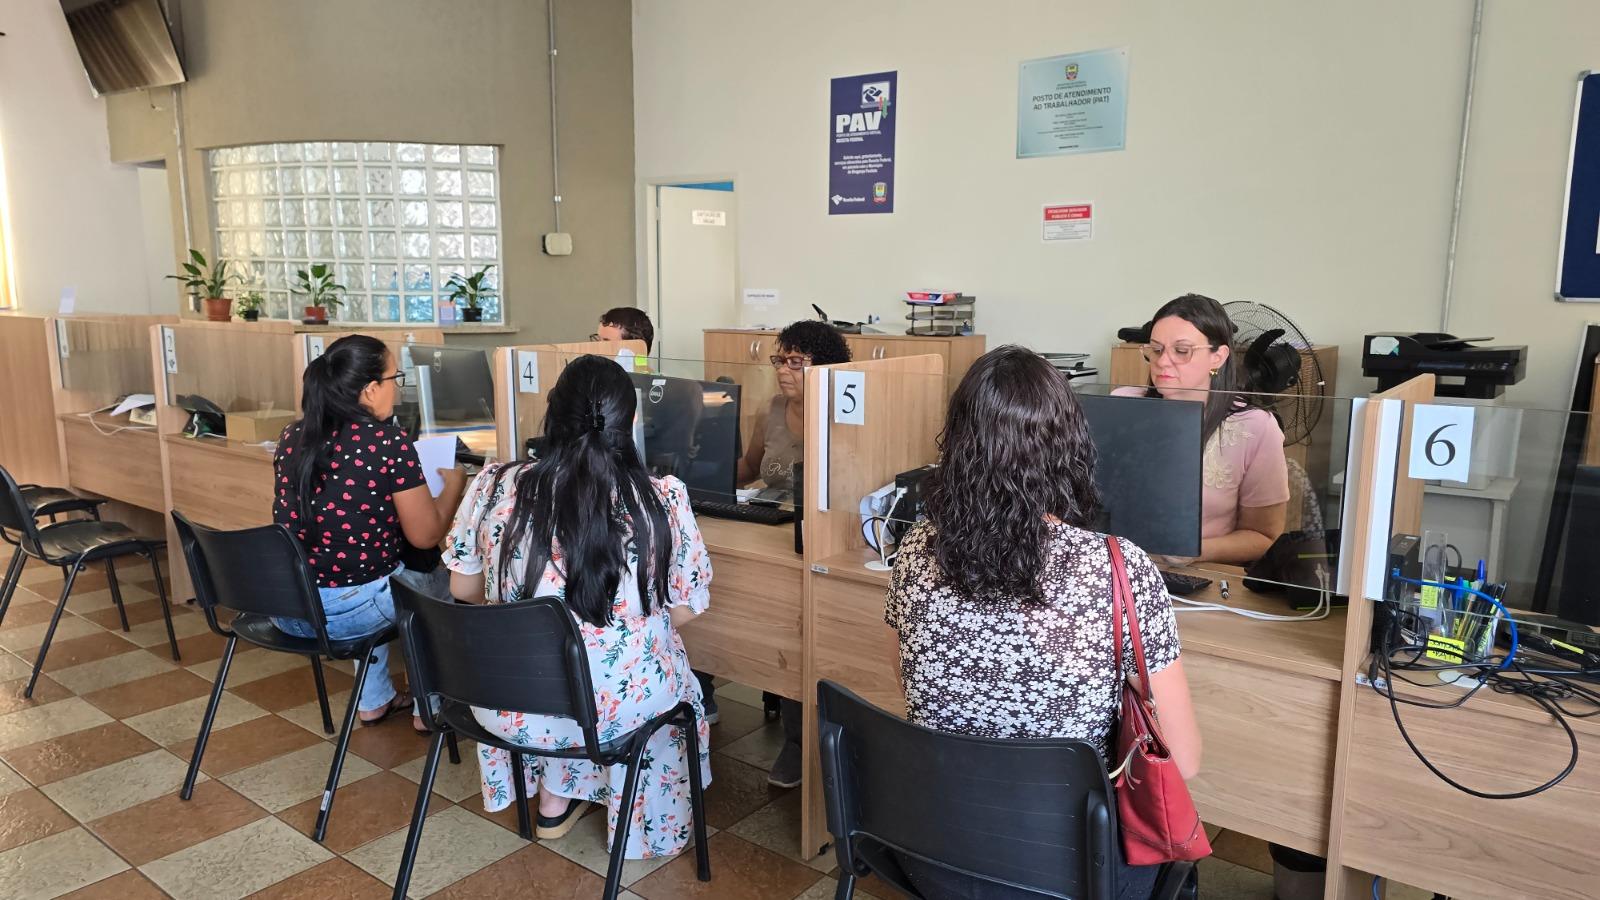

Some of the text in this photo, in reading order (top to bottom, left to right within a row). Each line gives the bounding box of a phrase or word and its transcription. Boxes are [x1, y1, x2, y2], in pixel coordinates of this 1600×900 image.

[1032, 87, 1111, 102] POSTO DE ATENDIMENTO
[1044, 97, 1091, 109] TRABALHADOR
[836, 110, 882, 134] PAV
[522, 361, 534, 385] 4
[842, 384, 857, 414] 5
[1424, 423, 1458, 467] 6
